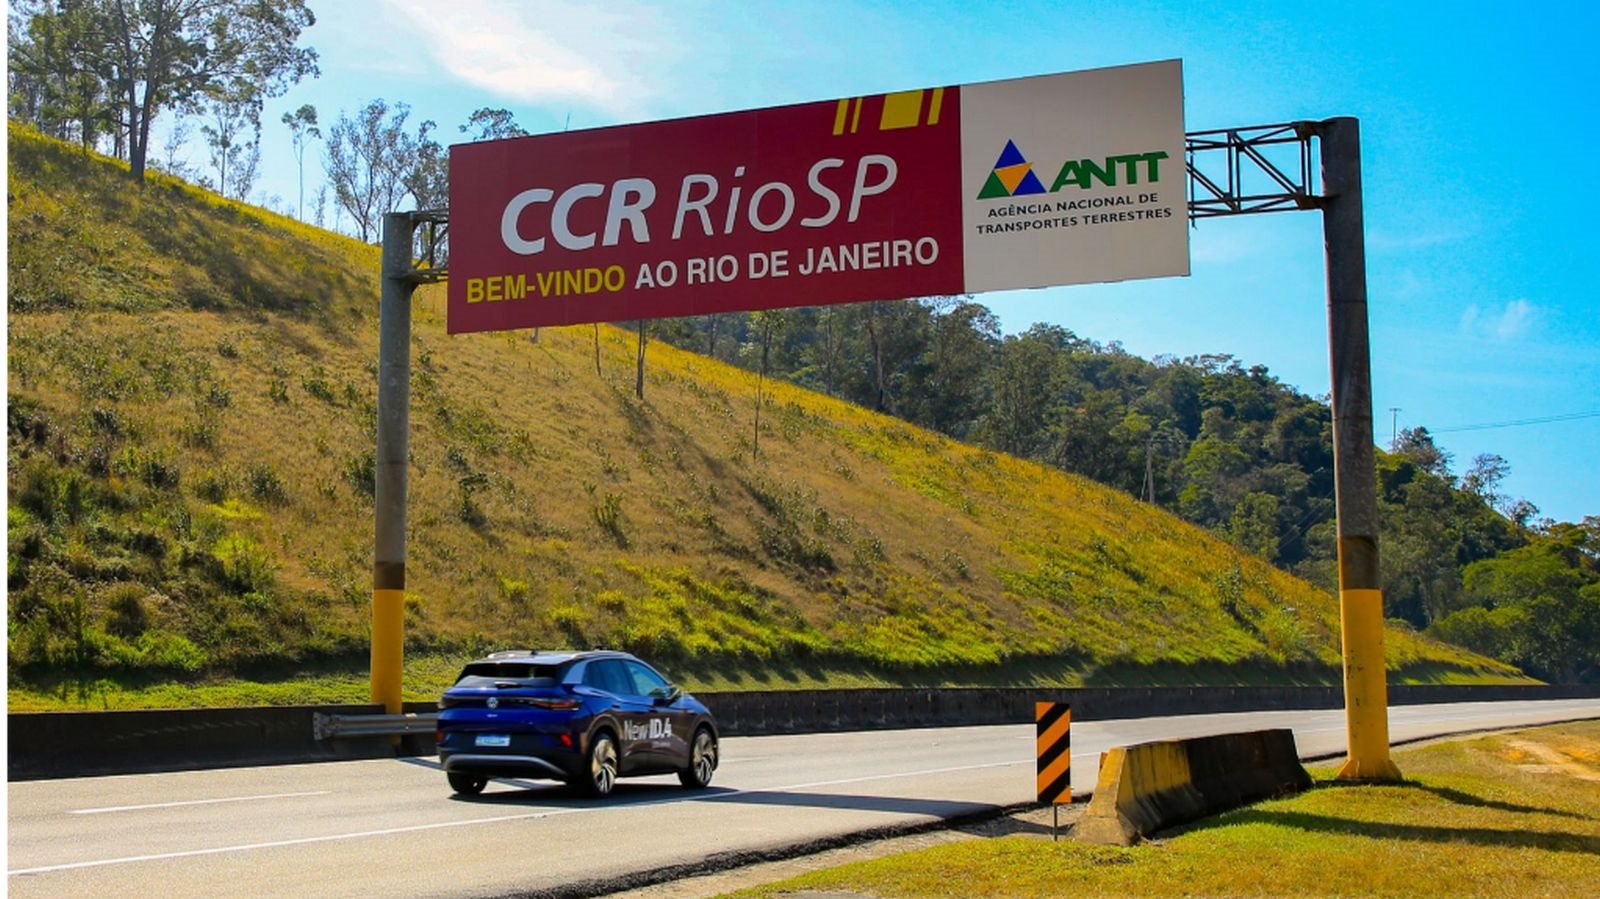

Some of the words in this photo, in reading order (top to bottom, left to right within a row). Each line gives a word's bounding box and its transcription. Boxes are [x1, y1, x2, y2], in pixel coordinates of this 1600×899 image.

[1049, 151, 1169, 192] ANTT
[501, 178, 656, 255] CCR
[976, 217, 1078, 234] TRANSPORTES
[1082, 208, 1172, 225] TERRESTRES
[988, 203, 1052, 218] AGÊNCIA
[1057, 195, 1134, 211] NACIONAL
[1139, 193, 1158, 203] DE
[466, 265, 626, 303] BEM-VINDO
[635, 260, 678, 289] AO
[687, 254, 739, 284] RIO
[748, 250, 790, 279] DE
[799, 236, 939, 275] JANEIRO
[624, 720, 649, 741] New
[650, 717, 672, 738] ID.4
